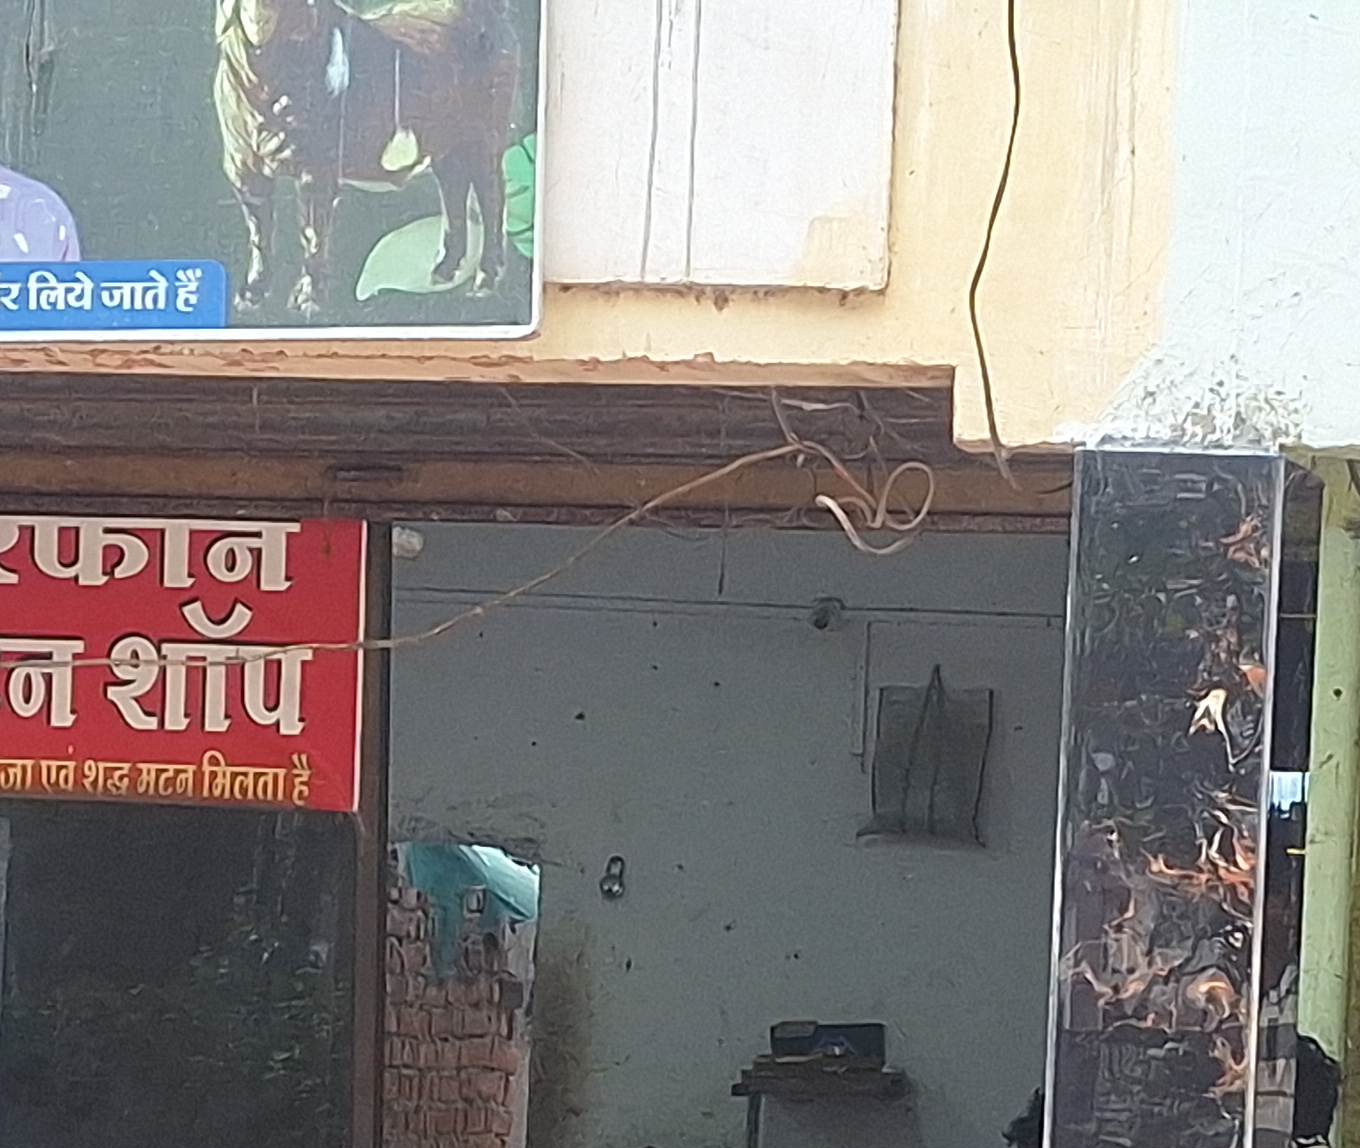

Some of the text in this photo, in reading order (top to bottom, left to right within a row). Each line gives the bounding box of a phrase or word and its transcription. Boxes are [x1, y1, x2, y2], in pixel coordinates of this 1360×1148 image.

[28, 271, 94, 309] लिये
[101, 270, 168, 309] जाते
[175, 269, 202, 311] हैं
[107, 601, 313, 735] शॉप
[40, 745, 76, 791] एवं
[136, 763, 197, 797] मटन
[202, 751, 287, 800] मिलता
[292, 754, 311, 806] है
